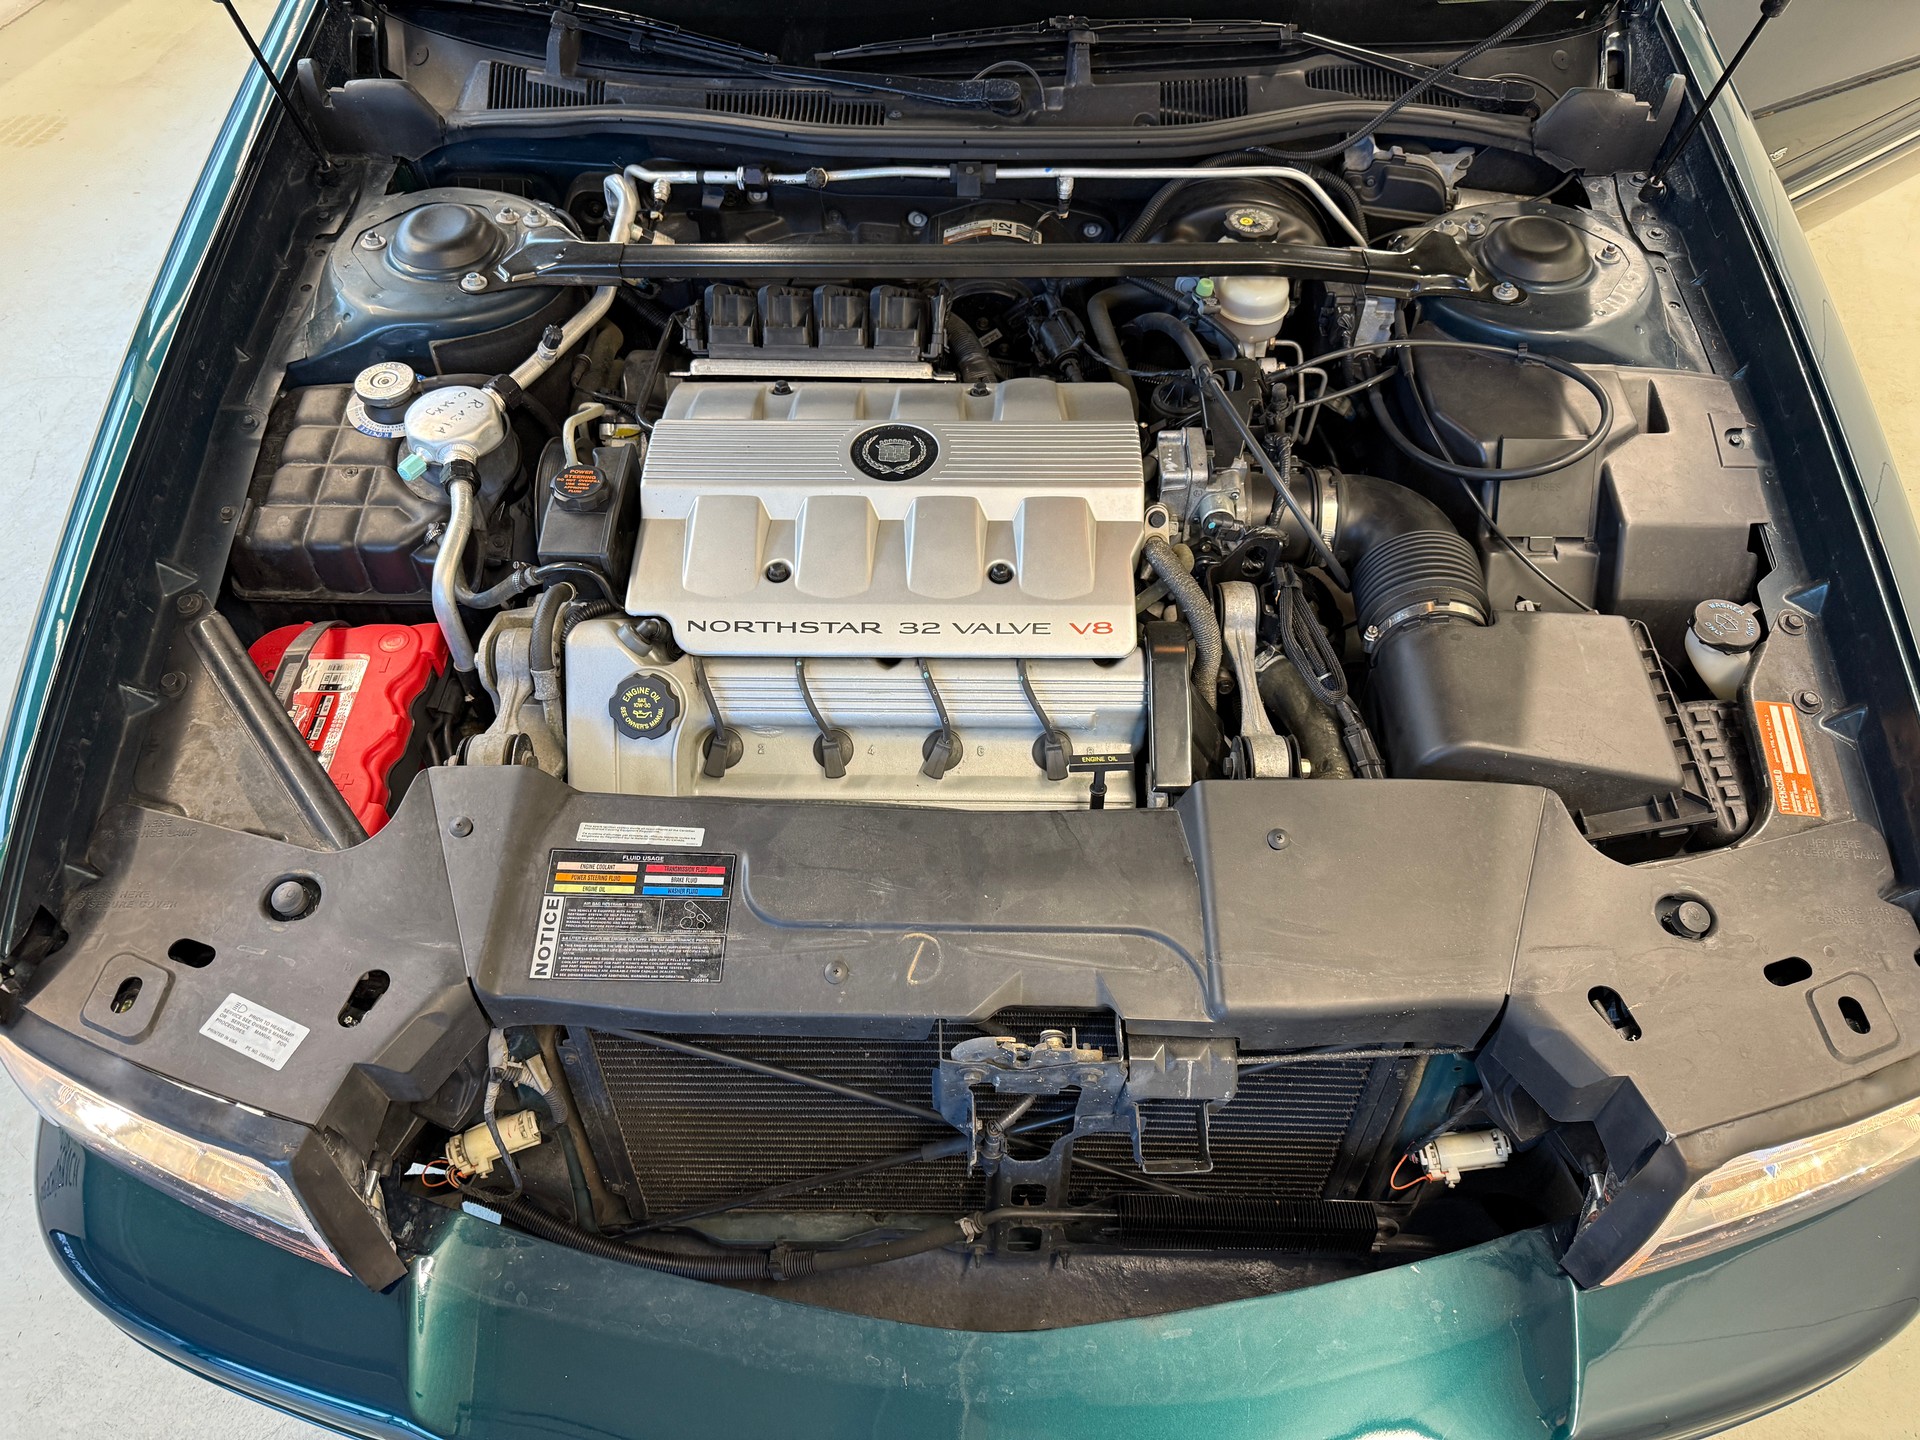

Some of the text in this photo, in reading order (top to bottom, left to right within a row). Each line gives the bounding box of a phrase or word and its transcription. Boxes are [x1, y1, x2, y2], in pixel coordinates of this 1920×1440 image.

[1708, 603, 1745, 615] WASHER
[686, 619, 1114, 635] NORTHSTAR 32 VALVE V8
[1705, 622, 1724, 636] ONLY
[622, 687, 661, 703] ENGINE OIL
[620, 706, 664, 729] SEE OWNER'S MANUAL
[868, 745, 875, 755] 4
[1774, 769, 1791, 811] TYPENSCHILD
[534, 898, 560, 976] NOTICE
[223, 1008, 290, 1043] SERVICE SEE OWNER'S MANUAL
[231, 1018, 250, 1030] SERVICE
[254, 1029, 272, 1042] MANUAL
[276, 1040, 287, 1048] FOR
[249, 1013, 263, 1023] PRIOR
[271, 1023, 295, 1038] HEADLAMP
[207, 1027, 224, 1038] PRINTED
[228, 1037, 238, 1045] USA
